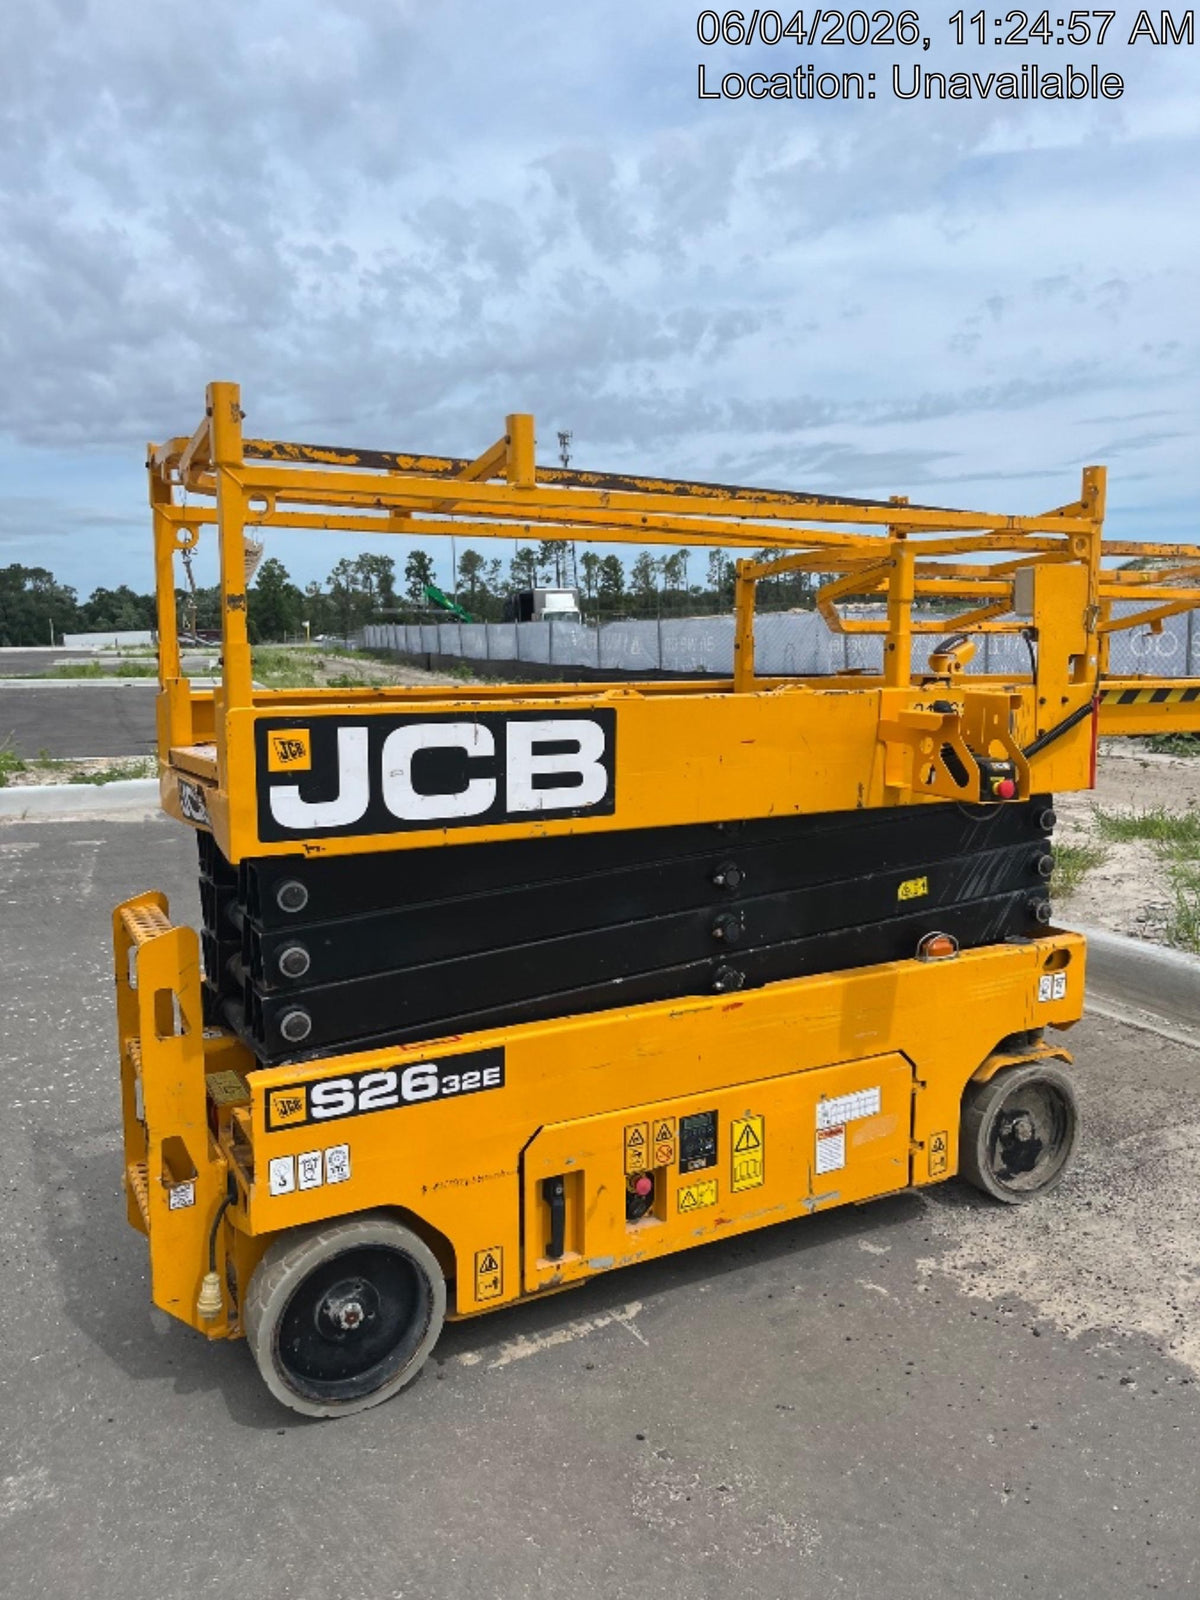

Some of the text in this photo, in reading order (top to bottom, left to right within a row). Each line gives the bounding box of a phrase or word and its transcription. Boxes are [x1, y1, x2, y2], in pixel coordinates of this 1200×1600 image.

[269, 719, 608, 829] JCB
[276, 738, 306, 763] JCB
[310, 1062, 501, 1120] S26 32E
